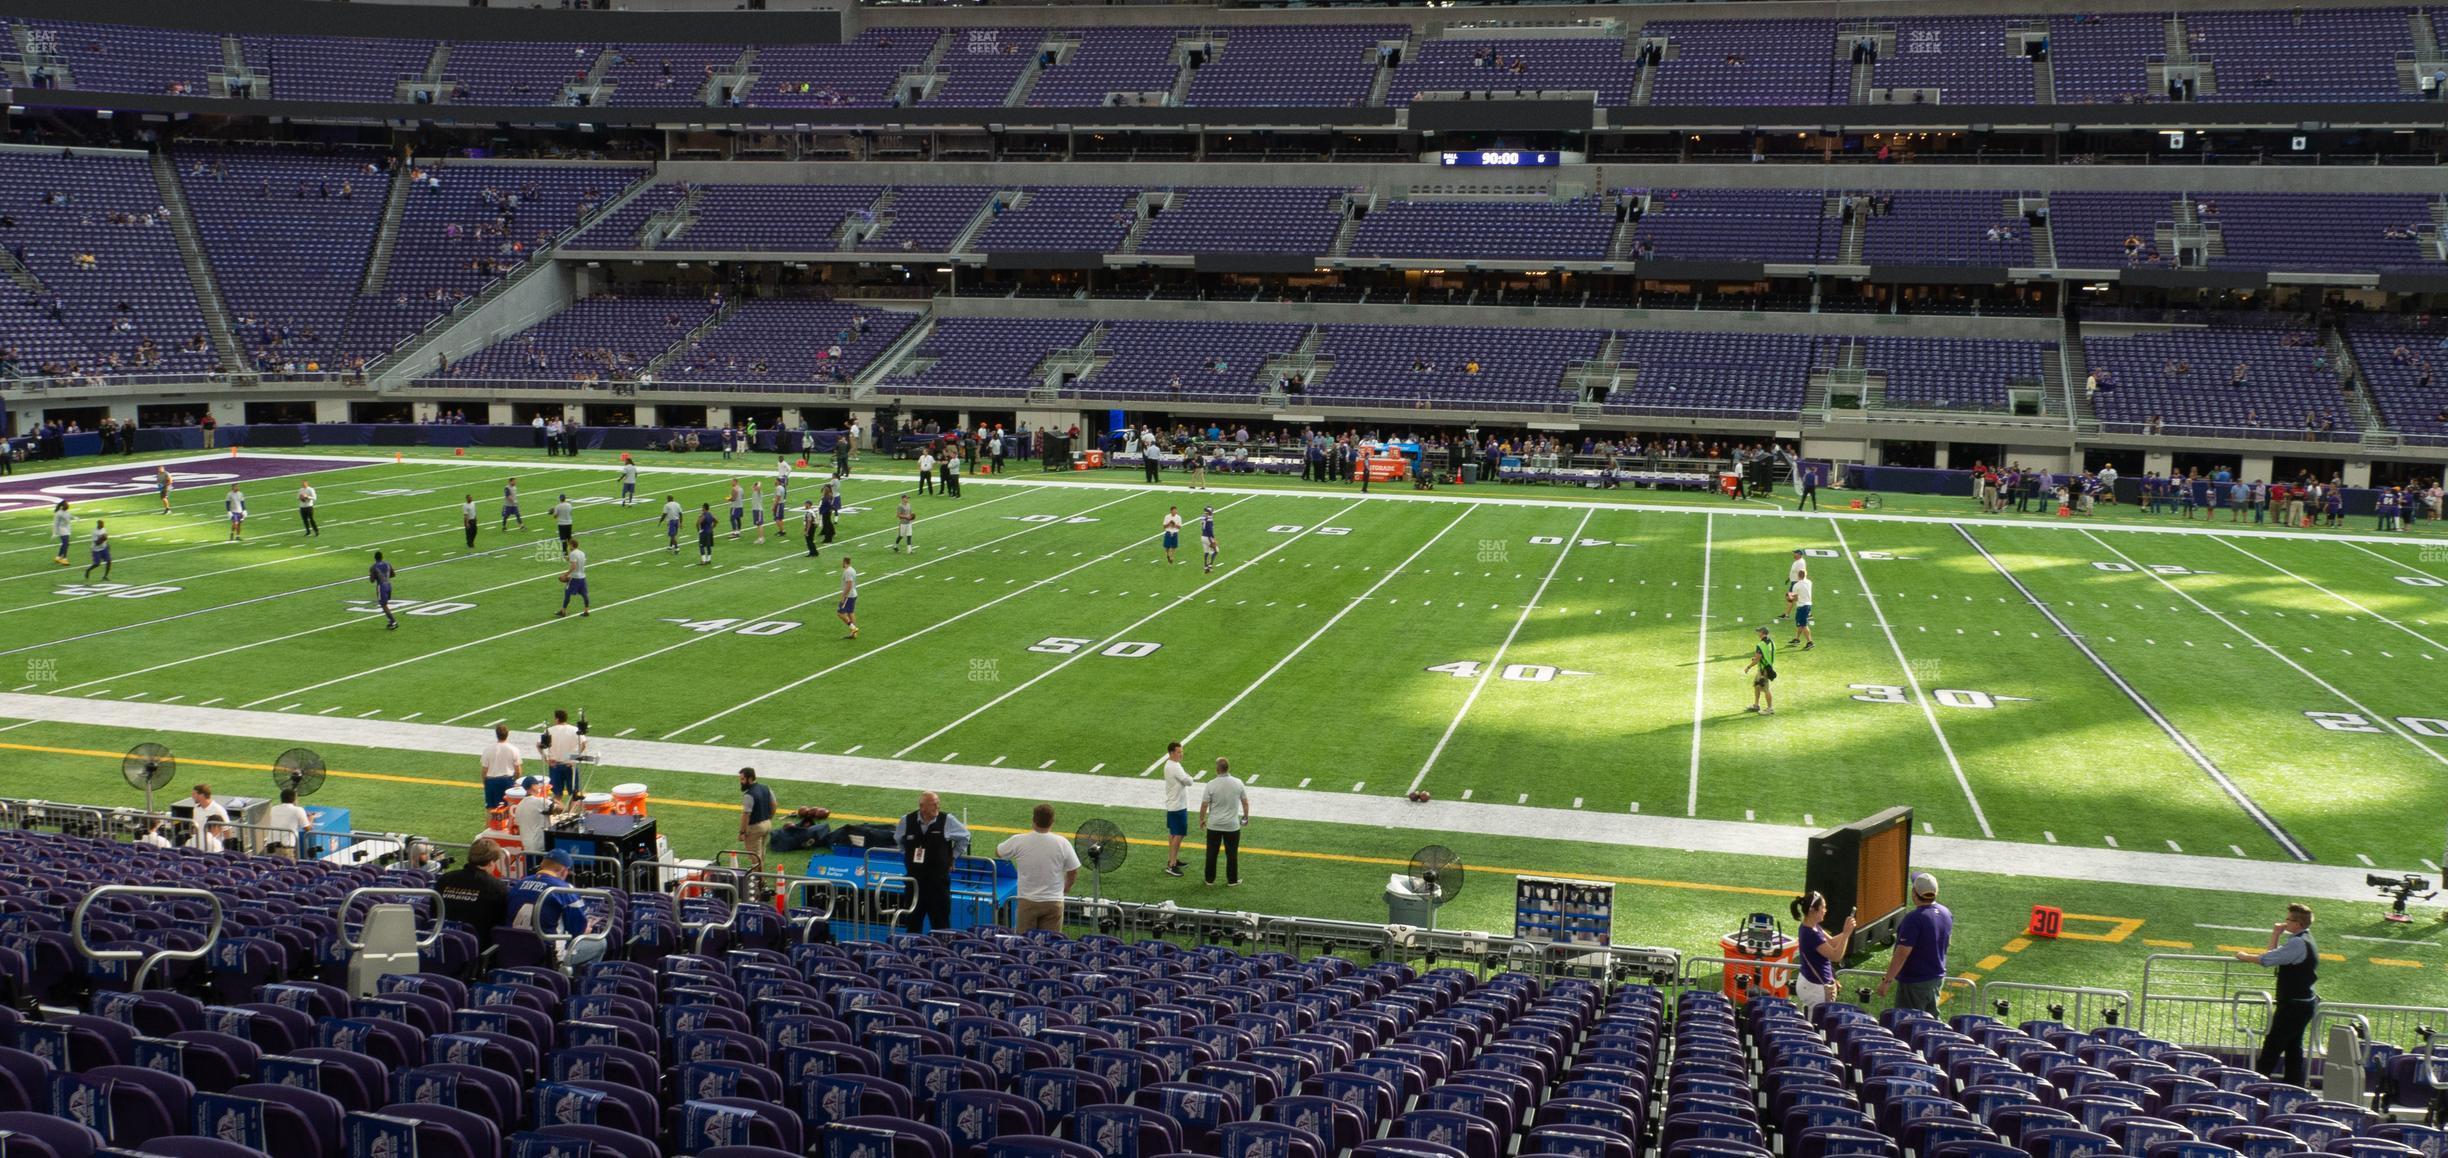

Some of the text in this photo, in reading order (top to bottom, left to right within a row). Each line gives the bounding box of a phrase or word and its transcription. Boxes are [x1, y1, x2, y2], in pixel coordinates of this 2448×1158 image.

[1482, 153, 1518, 165] 90:00
[1027, 637, 1163, 658] 50
[1426, 661, 1560, 682] 40
[1848, 684, 1996, 709] 30
[519, 880, 546, 891] FAVRE
[2033, 908, 2060, 934] 30
[1769, 957, 1789, 989] G
